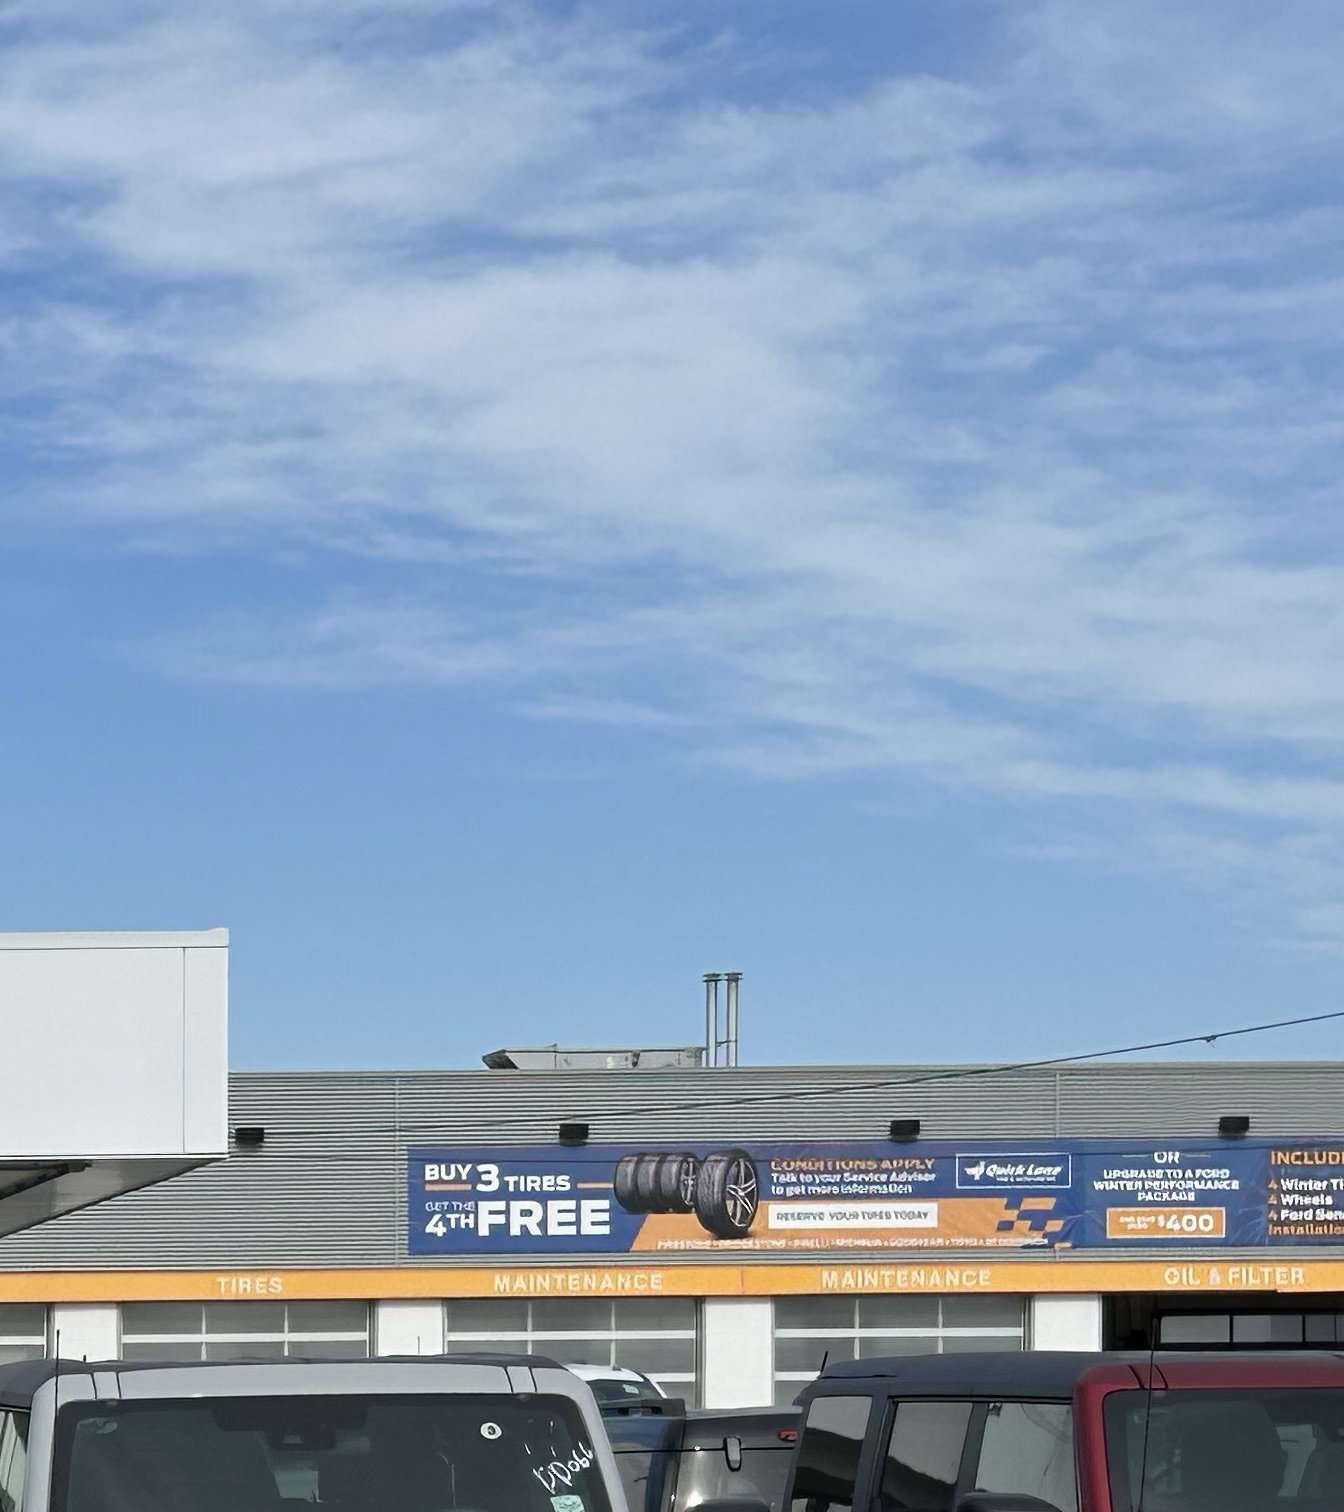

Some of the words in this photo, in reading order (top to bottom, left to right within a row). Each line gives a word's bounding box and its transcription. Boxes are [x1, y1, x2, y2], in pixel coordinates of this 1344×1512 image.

[424, 1163, 472, 1181] BUY
[476, 1163, 500, 1192] 3
[504, 1175, 571, 1192] TIRES
[771, 1172, 797, 1183] Talk
[799, 1172, 813, 1183] to
[1165, 1169, 1183, 1178] TO
[1184, 1169, 1194, 1178] A
[771, 1184, 784, 1195] to
[786, 1184, 806, 1197] get
[1094, 1180, 1142, 1190] WINTER
[1280, 1178, 1328, 1191] Winter
[1280, 1193, 1333, 1206] Wheels
[425, 1213, 475, 1237] 4TH
[477, 1199, 612, 1237] FREE
[1280, 1208, 1313, 1221] Ford
[1157, 1213, 1215, 1232] $400
[216, 1276, 284, 1295] TIRES
[494, 1271, 663, 1293] MAINTENANCE
[821, 1268, 992, 1289] MAINTENANCE
[1164, 1266, 1201, 1286] OIL
[1228, 1265, 1305, 1286] FILTER
